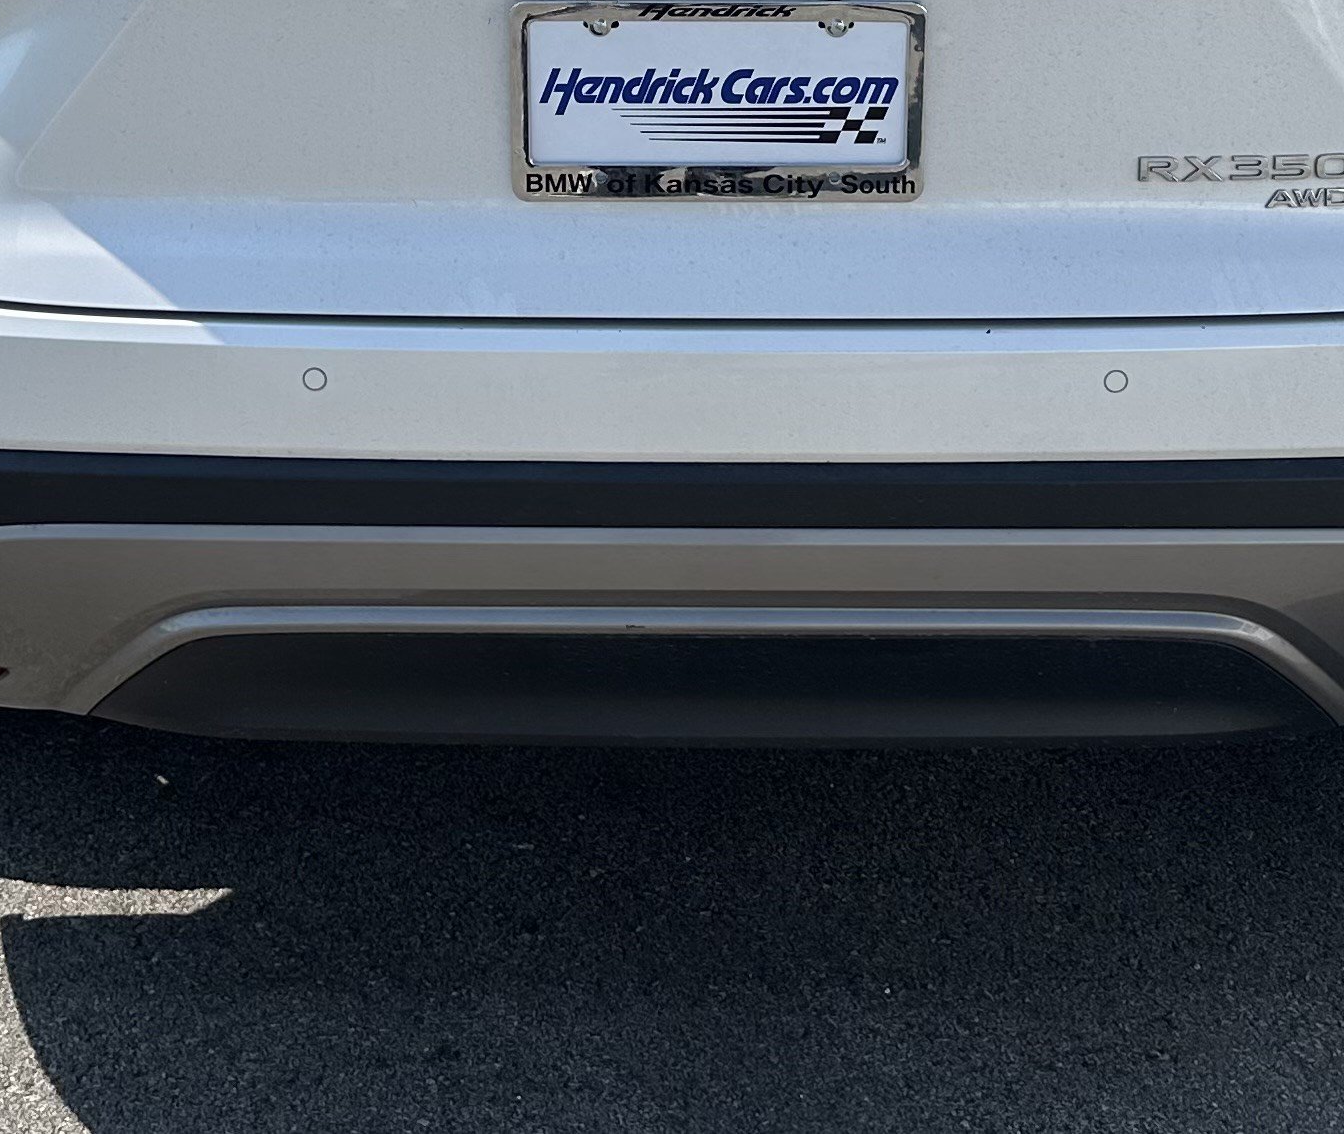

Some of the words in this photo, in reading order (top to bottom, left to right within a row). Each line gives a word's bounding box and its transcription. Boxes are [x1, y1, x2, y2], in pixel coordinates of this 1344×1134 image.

[637, 3, 797, 21] Hendrick
[525, 173, 593, 194] BMW
[606, 173, 637, 194] of
[643, 172, 755, 195] Kansas
[762, 172, 825, 199] City
[839, 173, 916, 195] South
